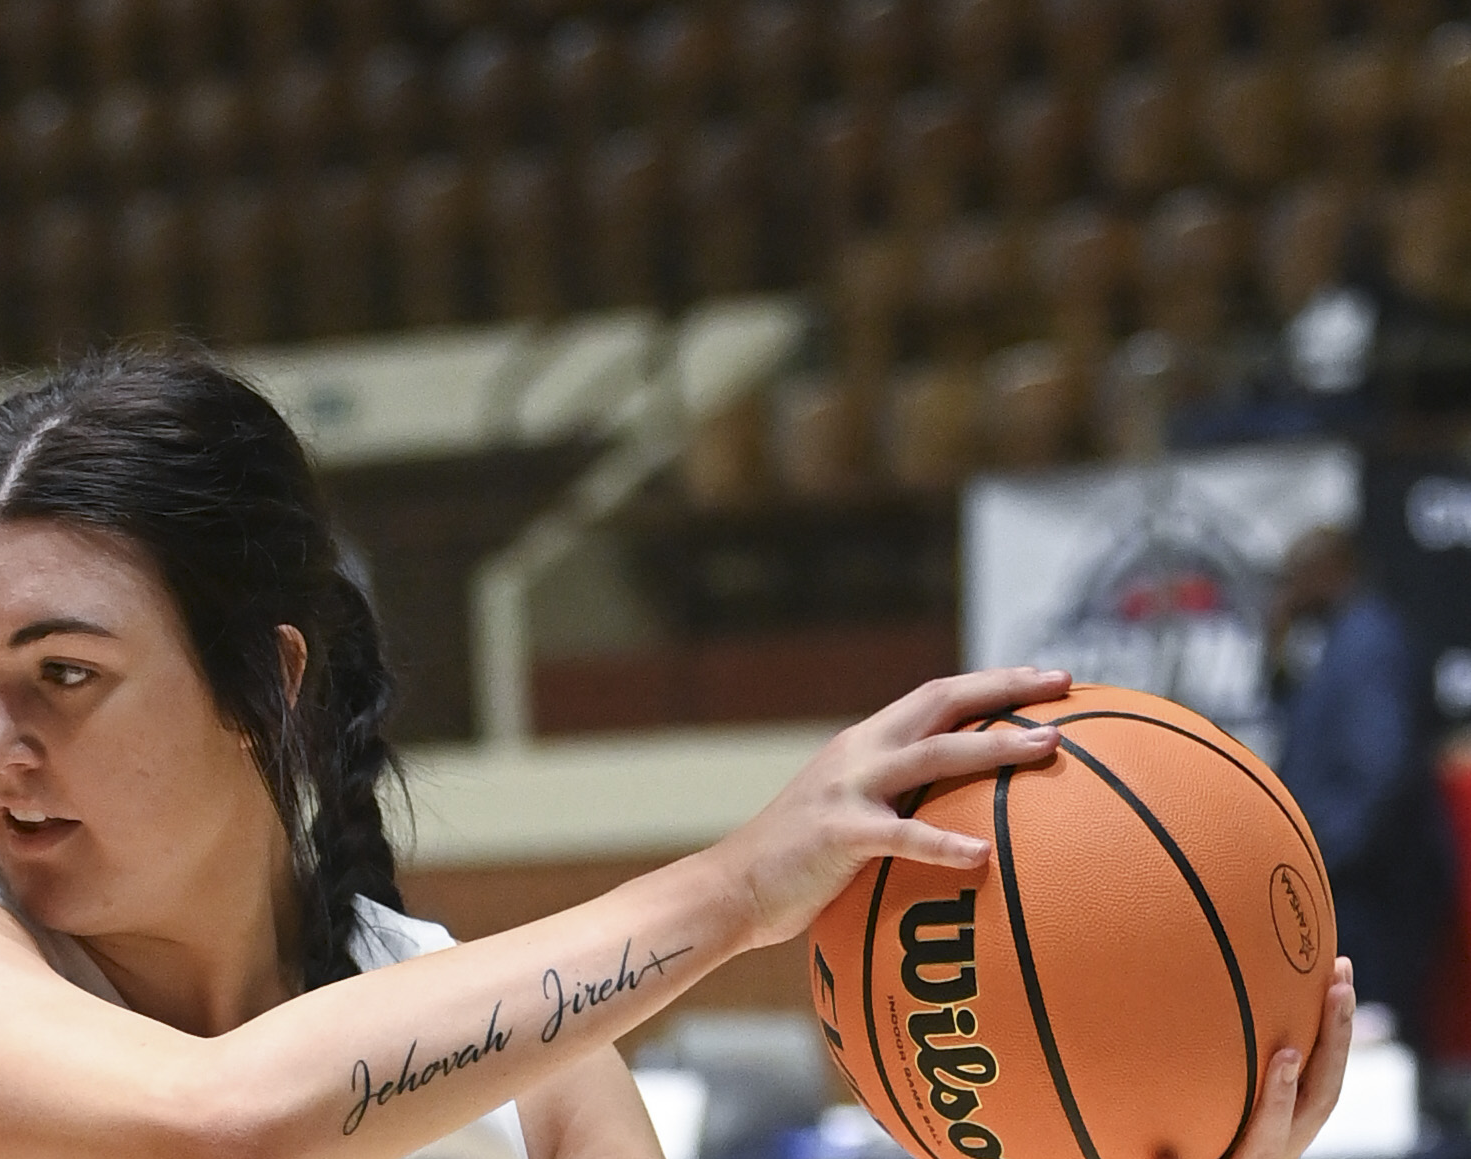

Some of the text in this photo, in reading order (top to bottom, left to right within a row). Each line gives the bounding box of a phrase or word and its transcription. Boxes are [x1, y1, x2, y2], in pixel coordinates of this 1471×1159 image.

[343, 1000, 512, 1136] Jehovah
[887, 994, 942, 1146] INDOOR GAME BALL
